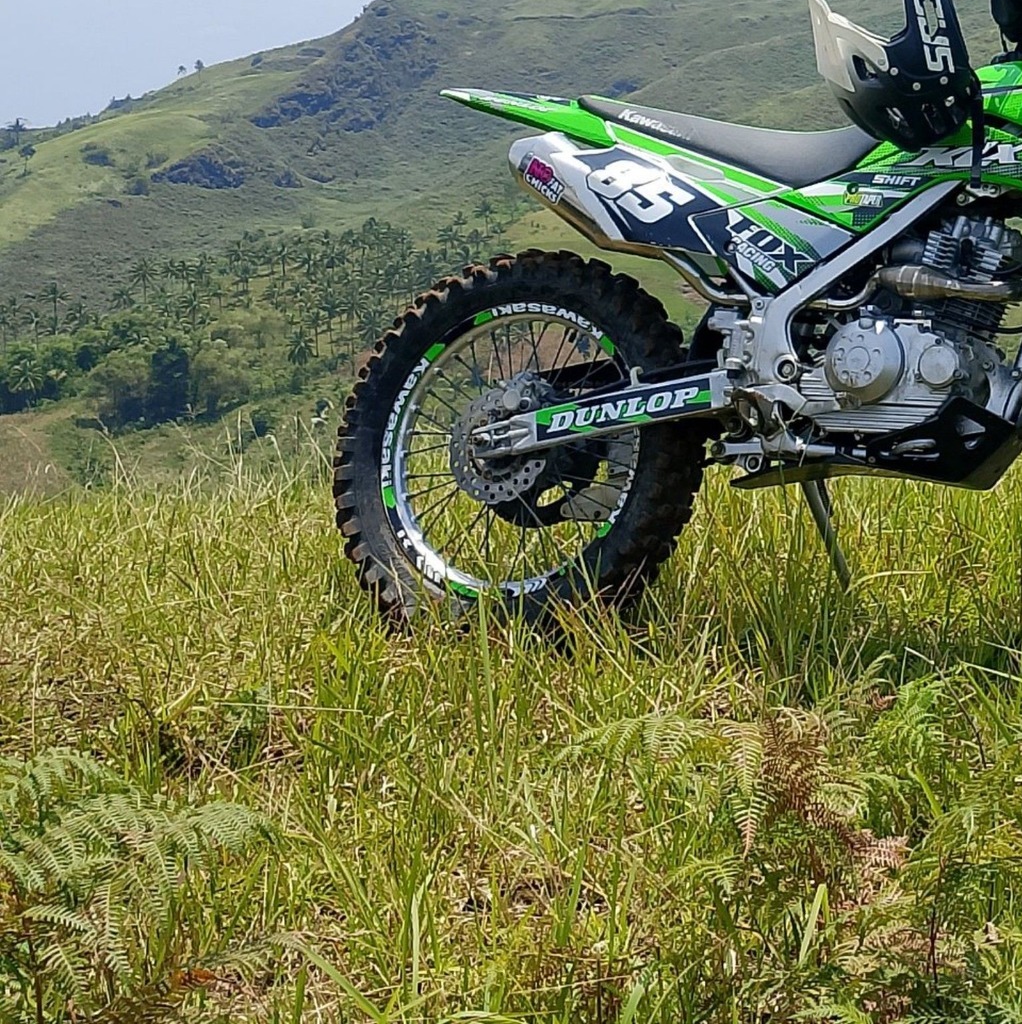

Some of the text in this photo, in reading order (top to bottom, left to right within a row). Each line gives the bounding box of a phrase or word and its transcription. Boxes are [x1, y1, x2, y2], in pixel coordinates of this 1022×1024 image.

[525, 174, 557, 203] CHICKS
[586, 159, 696, 224] 85
[872, 174, 922, 186] SHIFT
[731, 236, 777, 273] RACING
[491, 302, 604, 340] Kawasaki
[381, 357, 430, 488] Kawasaki
[546, 386, 699, 433] DUNLOP
